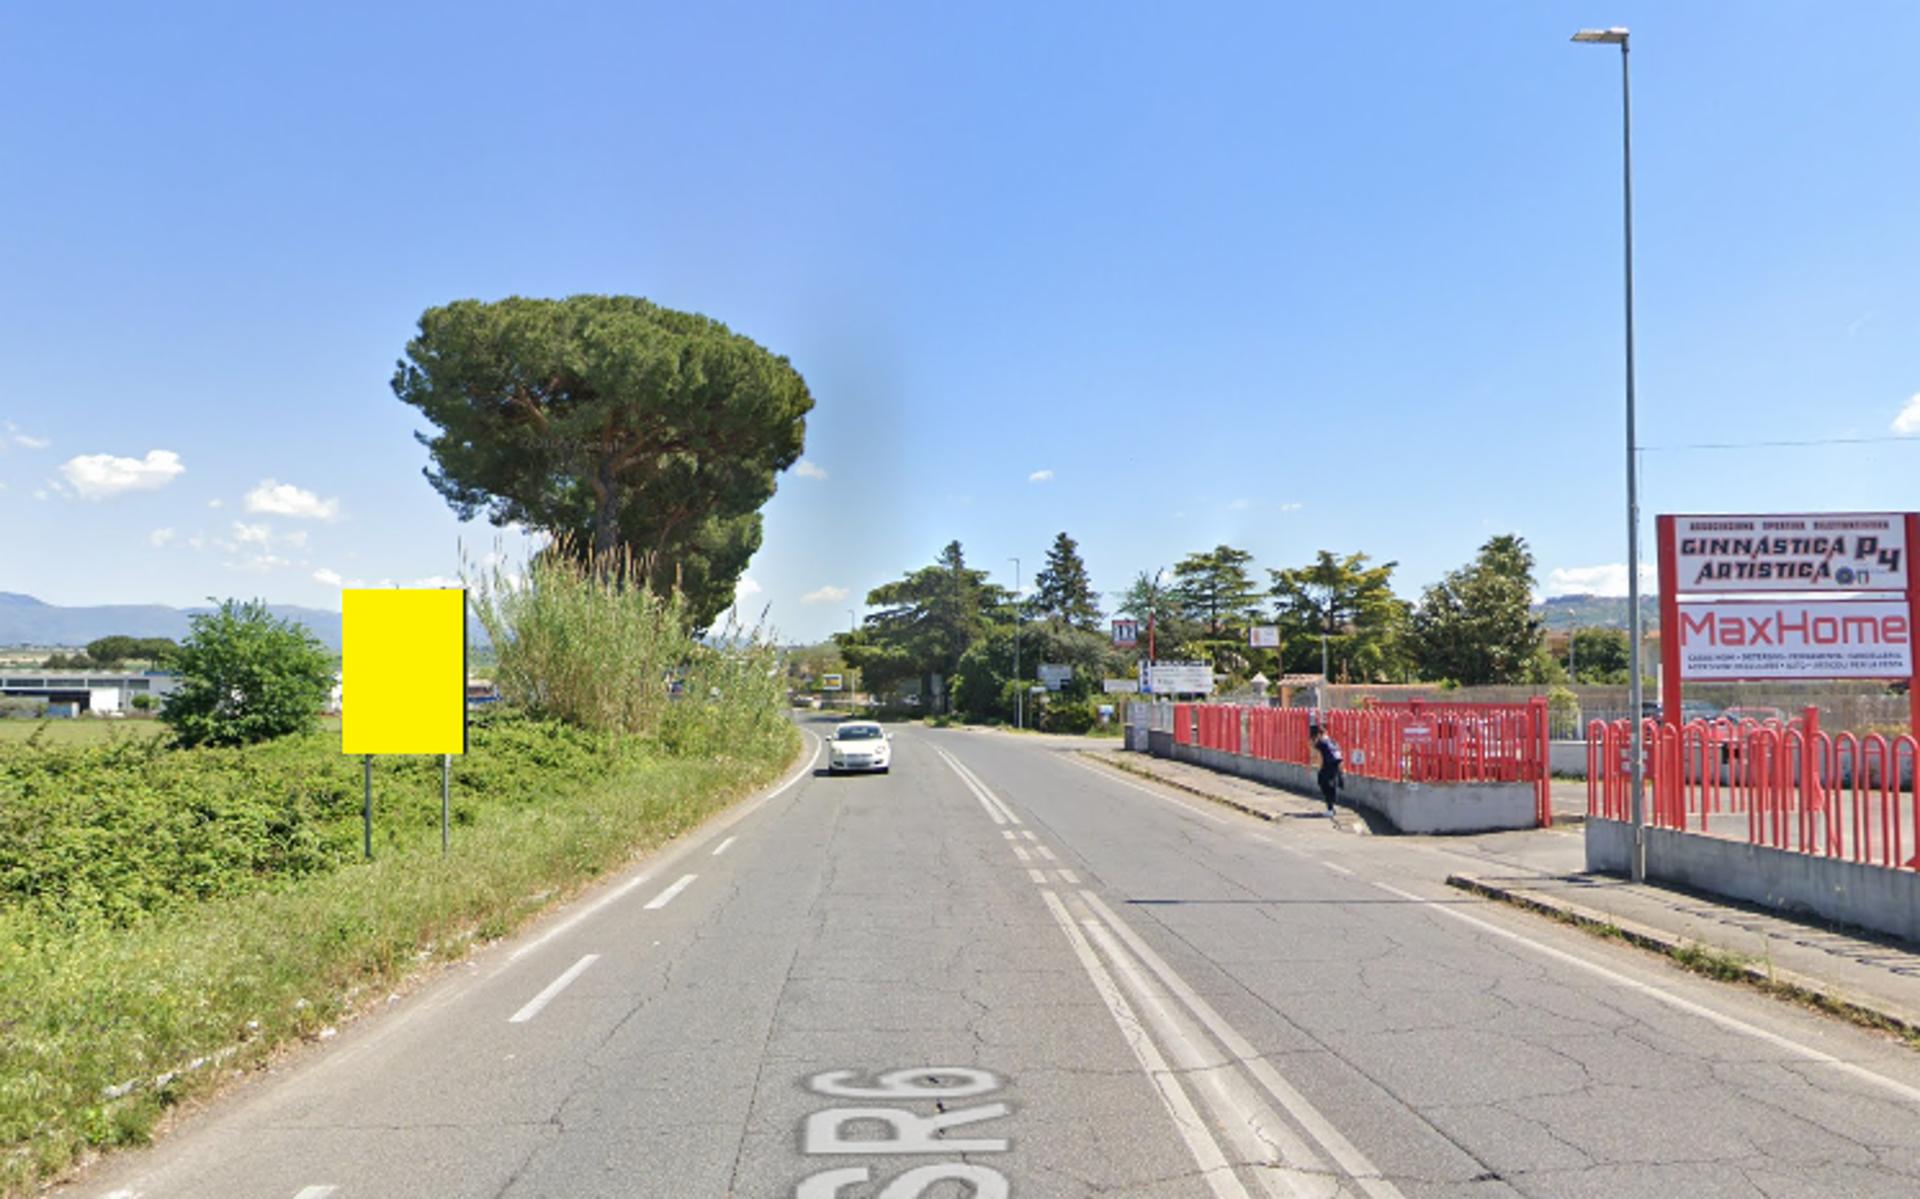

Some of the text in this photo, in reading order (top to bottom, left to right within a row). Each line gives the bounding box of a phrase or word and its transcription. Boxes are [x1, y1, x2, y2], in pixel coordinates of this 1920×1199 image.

[1681, 536, 1846, 559] GINNASTICA
[1694, 560, 1831, 584] ARTISTICA
[1680, 609, 1908, 647] MaxHome
